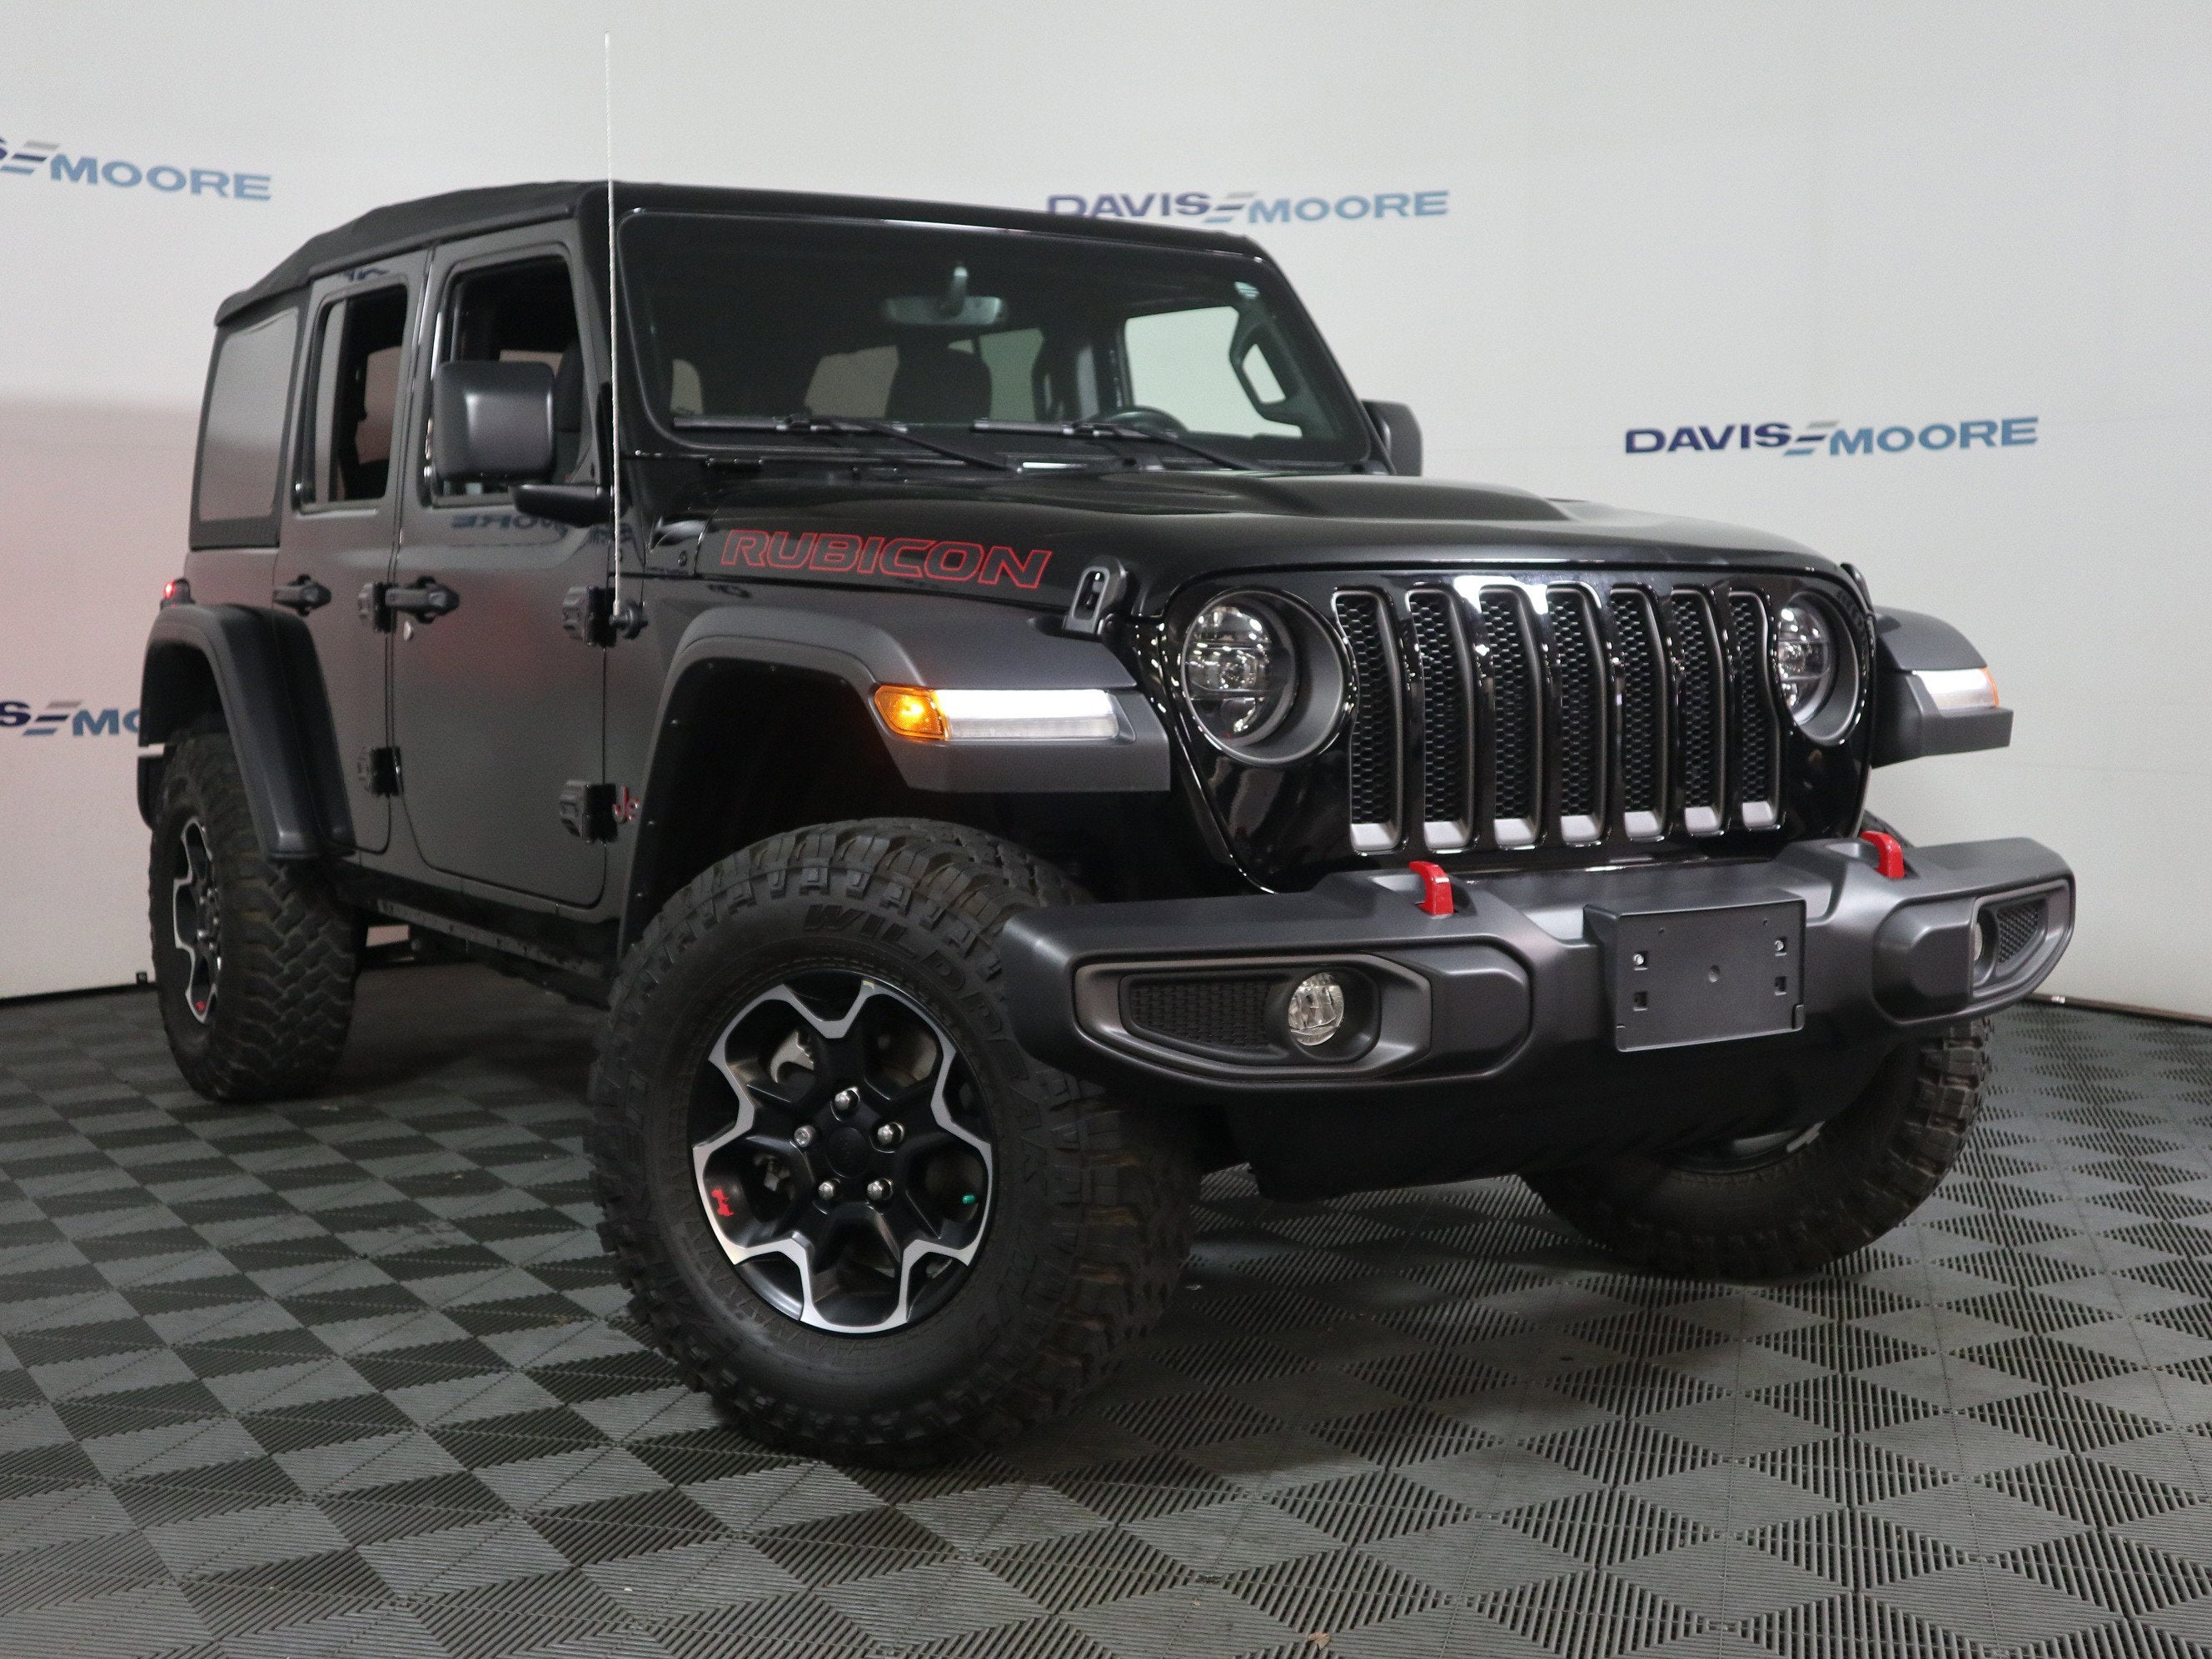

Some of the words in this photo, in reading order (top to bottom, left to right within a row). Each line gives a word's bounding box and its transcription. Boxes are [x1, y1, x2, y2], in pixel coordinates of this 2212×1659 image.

[50, 153, 272, 202] MOORE
[1047, 192, 1211, 218] DAVIS
[1247, 190, 1449, 223] MOORE
[1625, 421, 1791, 454] DAVIS
[1830, 416, 2039, 456] MOORE
[720, 528, 1053, 590] RUBICON
